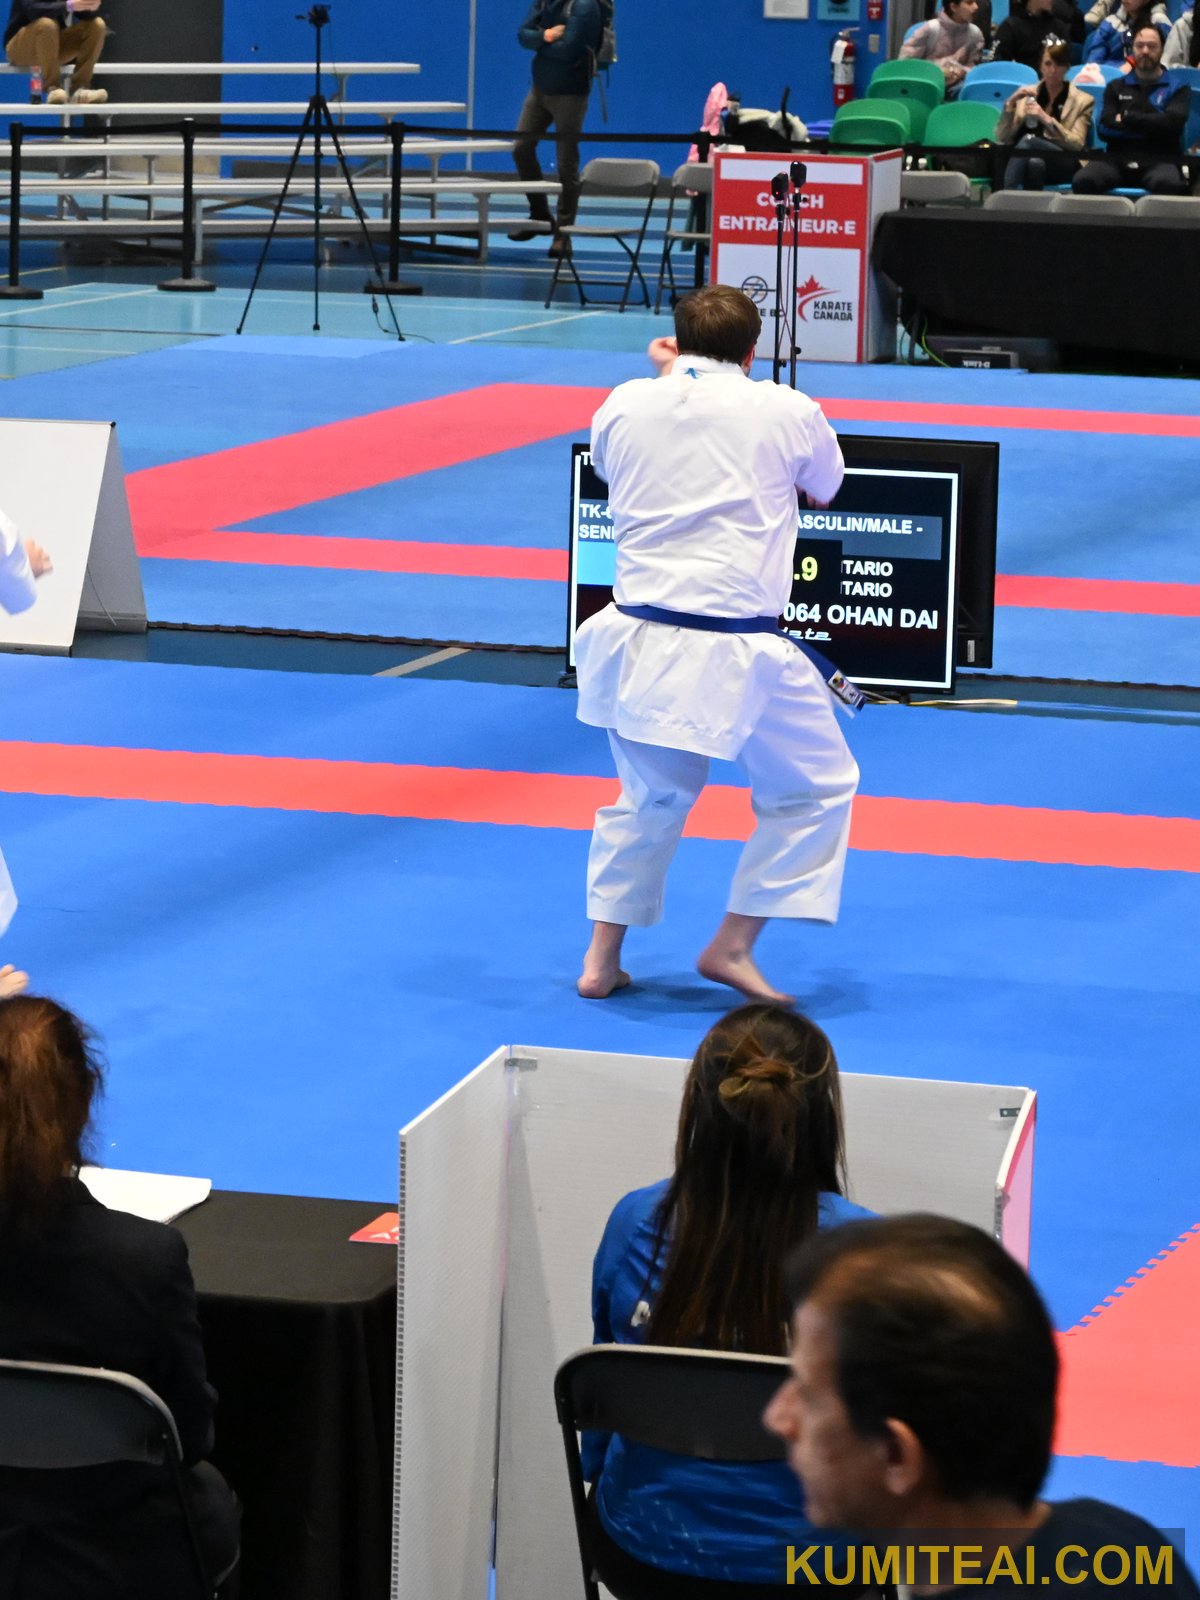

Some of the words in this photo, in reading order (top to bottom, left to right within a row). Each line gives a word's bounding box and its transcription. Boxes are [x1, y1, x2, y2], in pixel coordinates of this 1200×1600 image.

[814, 301, 853, 312] KARATE
[814, 311, 853, 322] CANADA
[841, 560, 893, 577] TARIO
[840, 581, 893, 598] TARIO
[827, 604, 893, 627] OHAN
[900, 608, 938, 630] DAI
